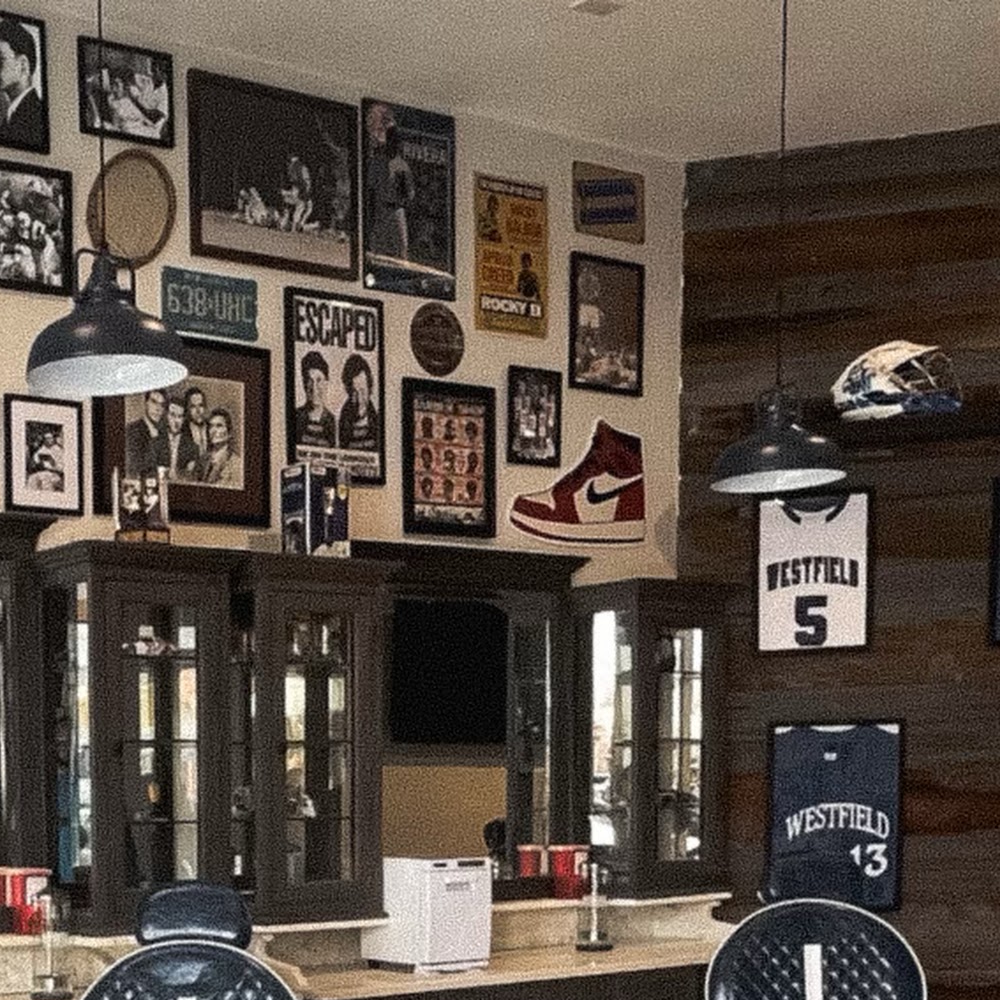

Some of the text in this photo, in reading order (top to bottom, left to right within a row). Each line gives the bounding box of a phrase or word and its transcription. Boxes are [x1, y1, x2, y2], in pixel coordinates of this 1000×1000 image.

[481, 295, 526, 315] ROCKY
[296, 300, 376, 351] ESCAPED
[766, 556, 860, 591] WESTFIELD
[794, 595, 828, 646] 5
[785, 803, 890, 841] WESTFIELD
[850, 843, 889, 877] 13
